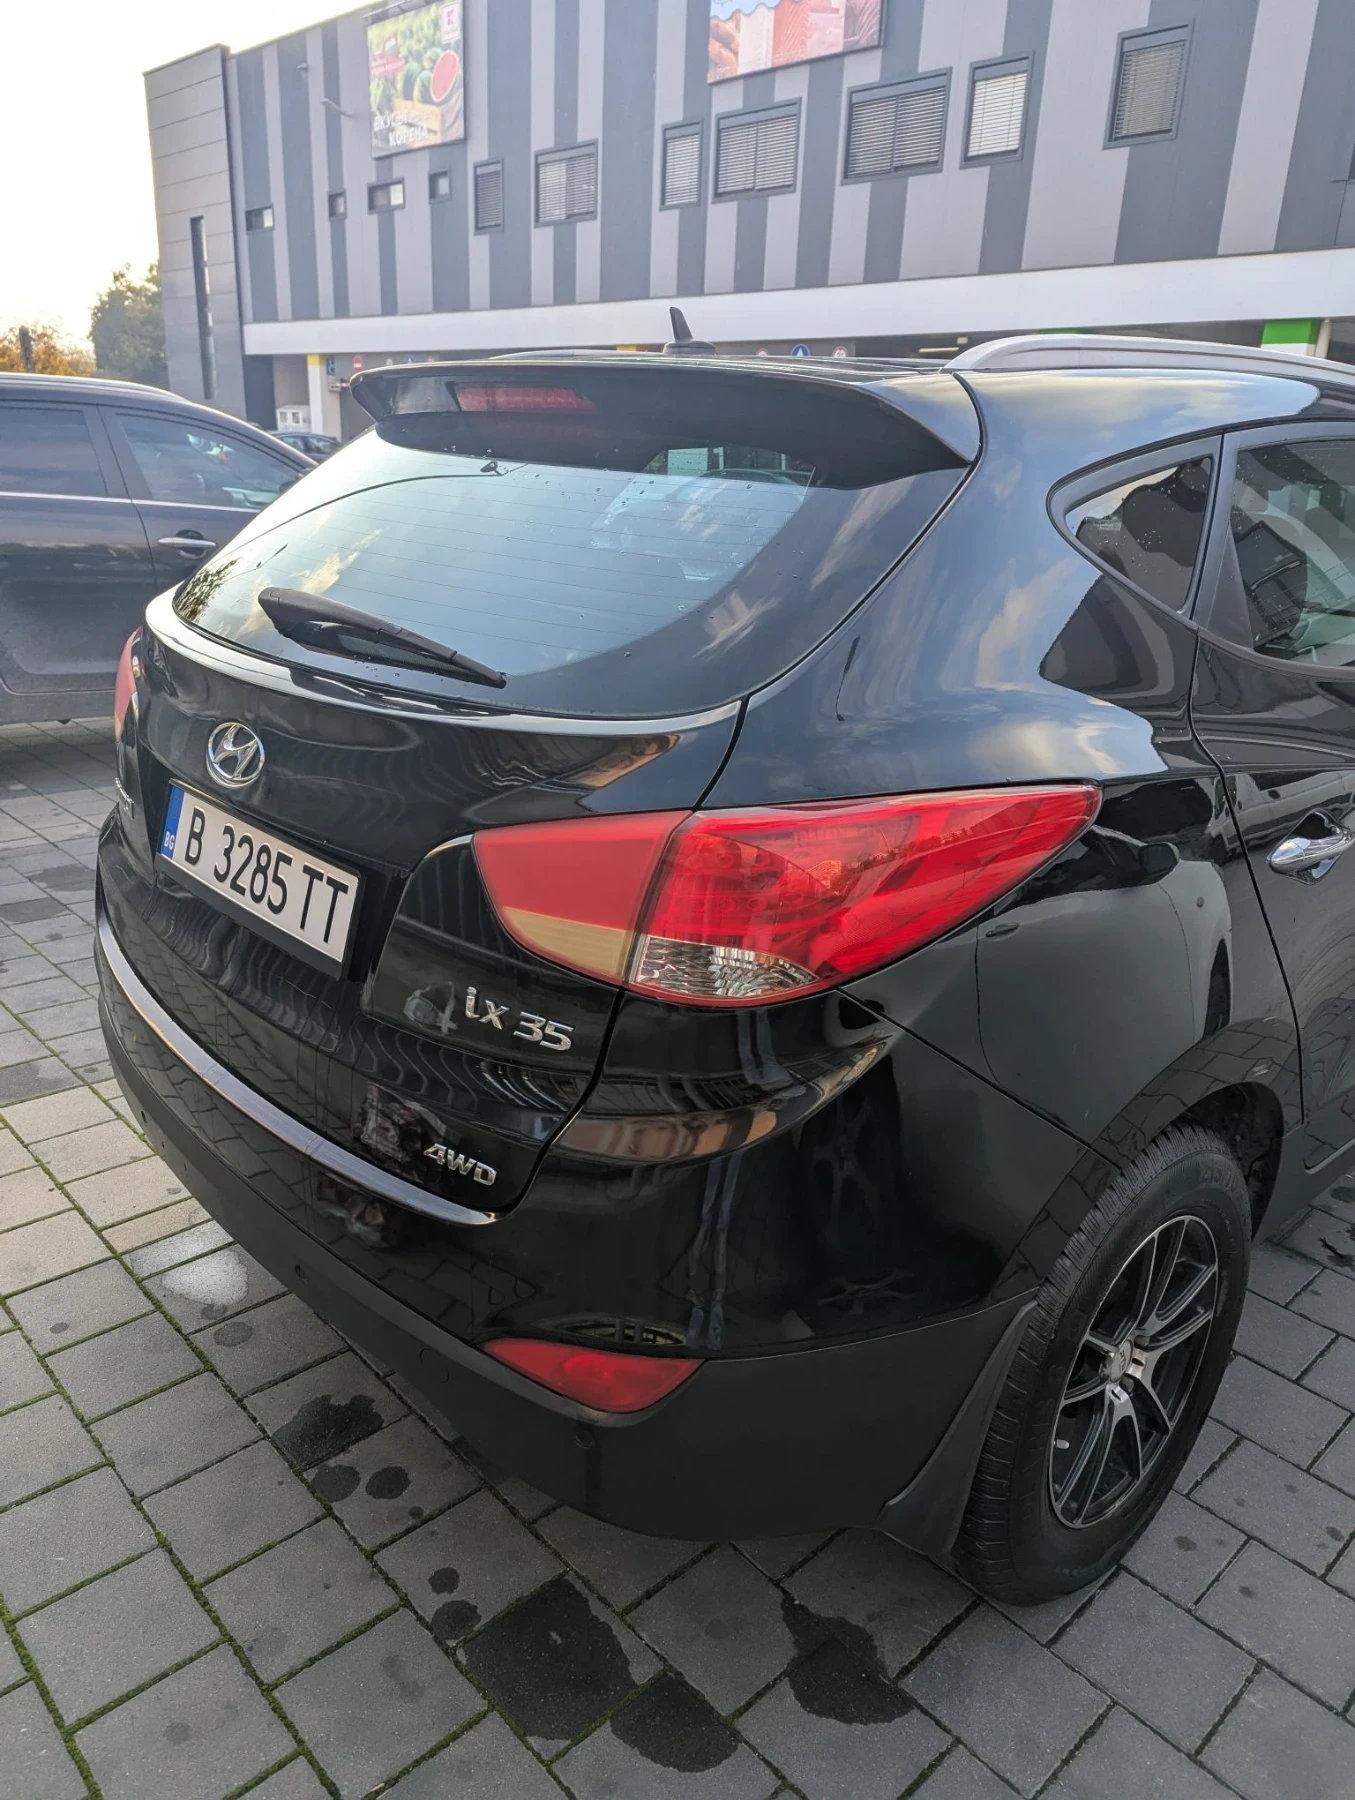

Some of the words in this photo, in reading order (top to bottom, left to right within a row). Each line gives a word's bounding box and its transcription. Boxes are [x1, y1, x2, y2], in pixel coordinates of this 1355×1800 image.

[164, 832, 176, 850] BG
[184, 806, 206, 866] B
[213, 823, 293, 915] 3285
[299, 864, 349, 943] TT
[423, 1143, 498, 1186] 4WD
